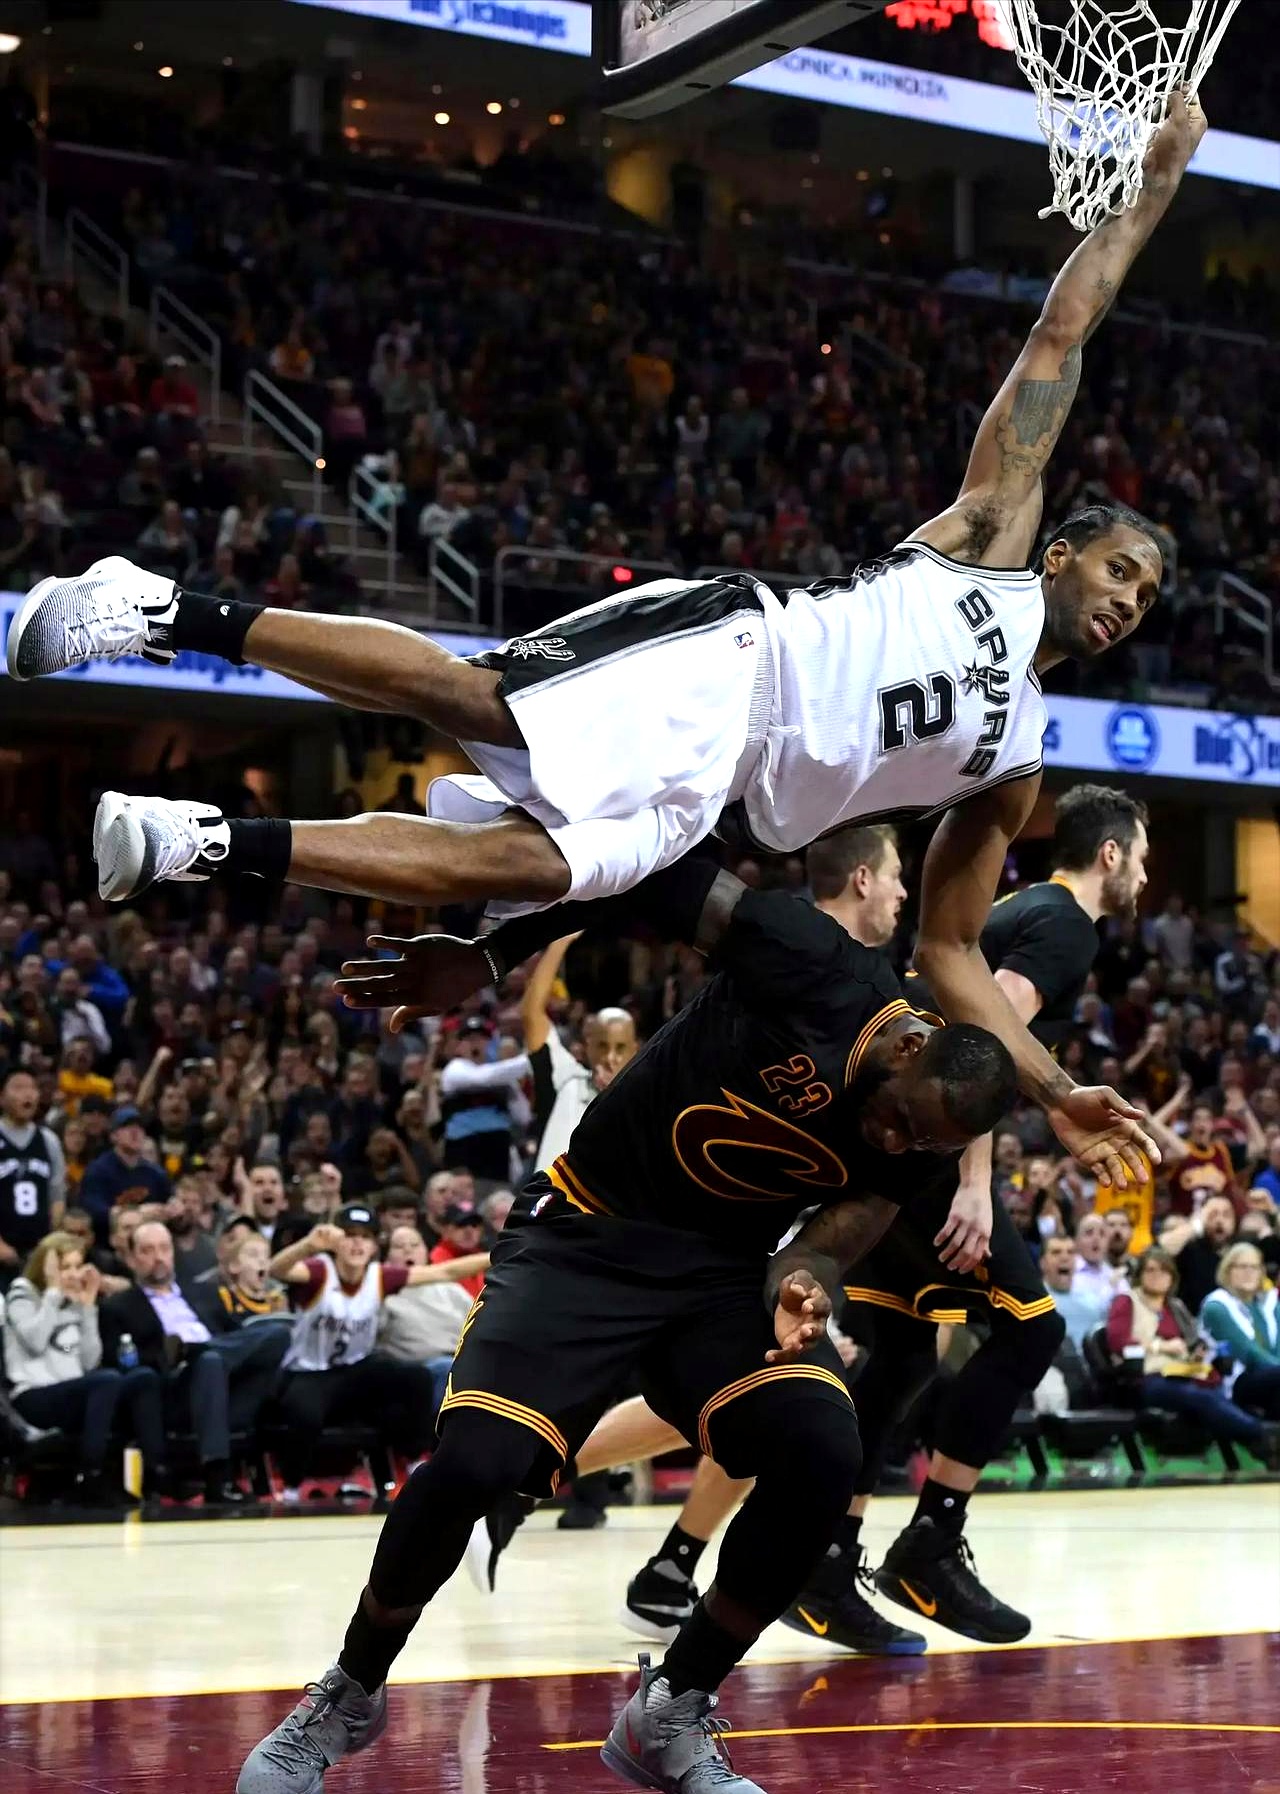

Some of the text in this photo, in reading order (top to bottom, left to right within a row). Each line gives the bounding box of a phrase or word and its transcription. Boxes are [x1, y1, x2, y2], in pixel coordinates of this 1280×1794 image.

[877, 670, 956, 756] 2
[954, 583, 1010, 778] SPURS
[759, 1054, 832, 1118] 23
[13, 1181, 38, 1216] 8
